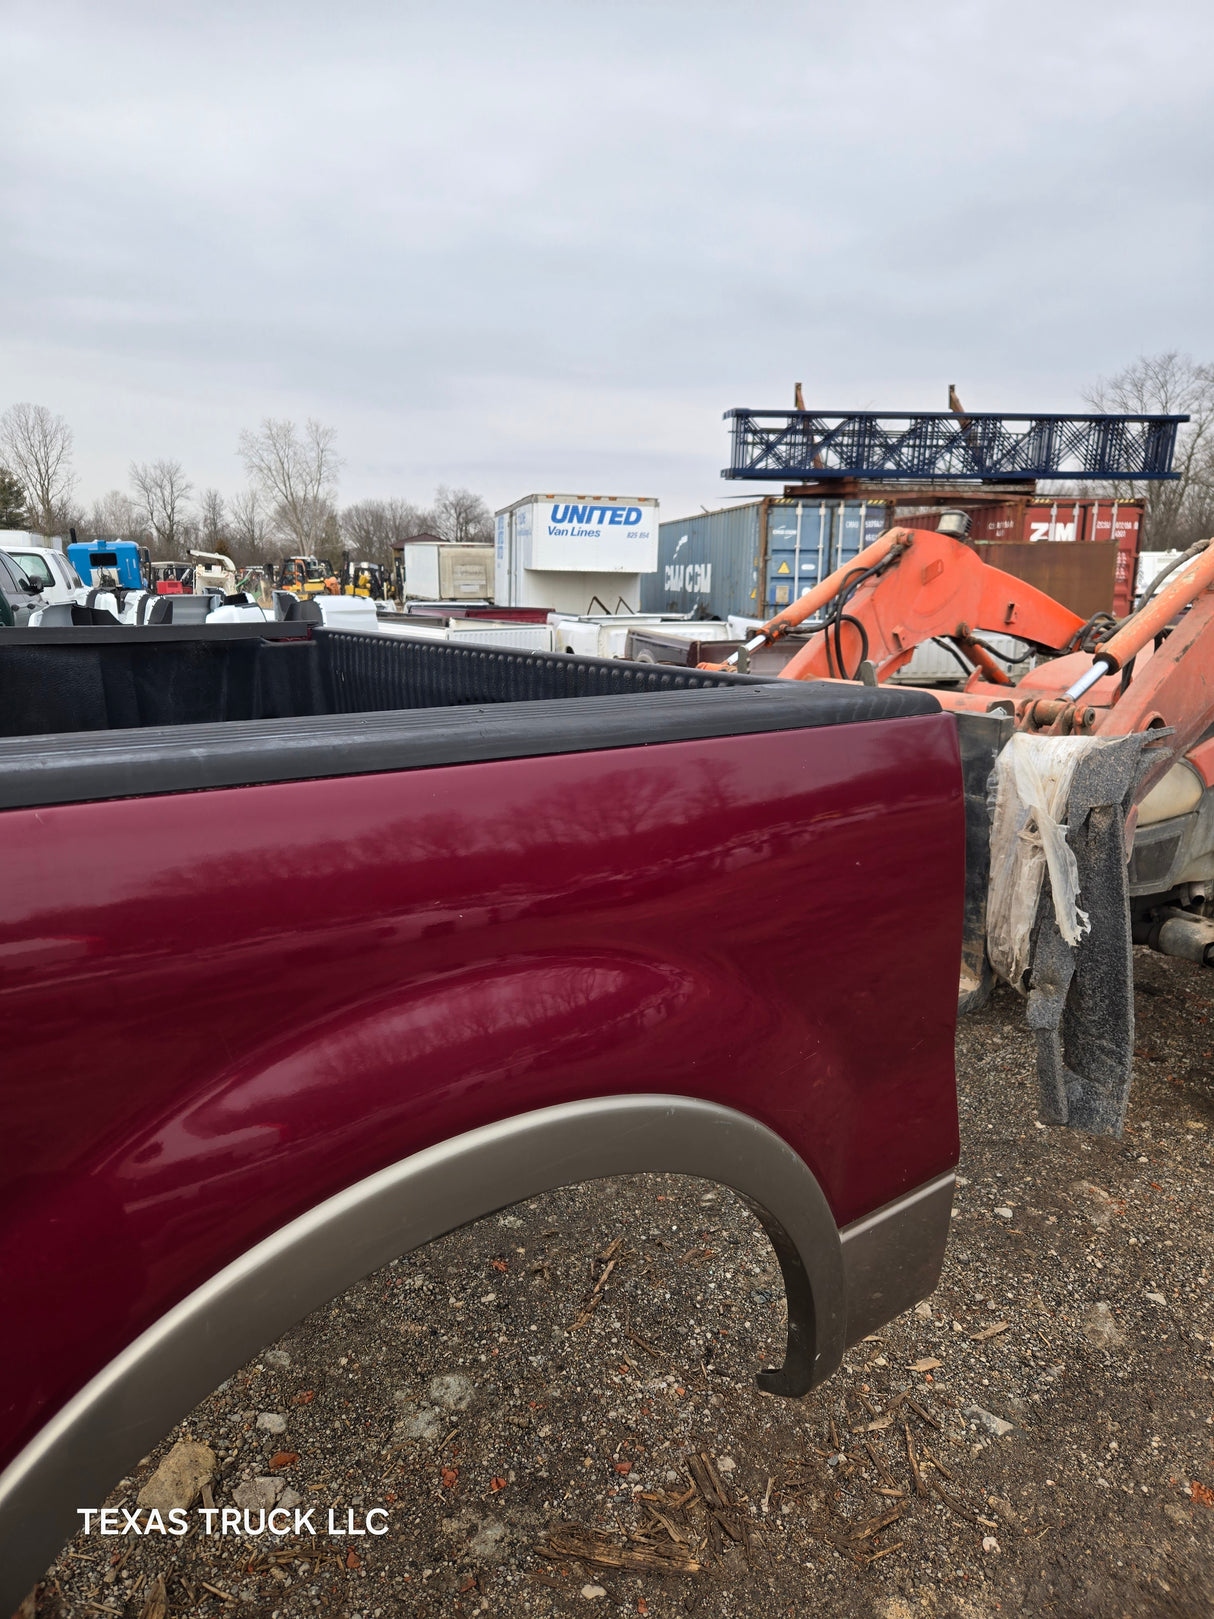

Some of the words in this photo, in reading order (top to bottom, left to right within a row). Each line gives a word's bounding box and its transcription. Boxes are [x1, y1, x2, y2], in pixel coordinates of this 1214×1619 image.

[551, 504, 642, 526] UNITED
[548, 525, 569, 537] Van
[570, 527, 601, 538] Lines
[1029, 522, 1076, 541] ZIM
